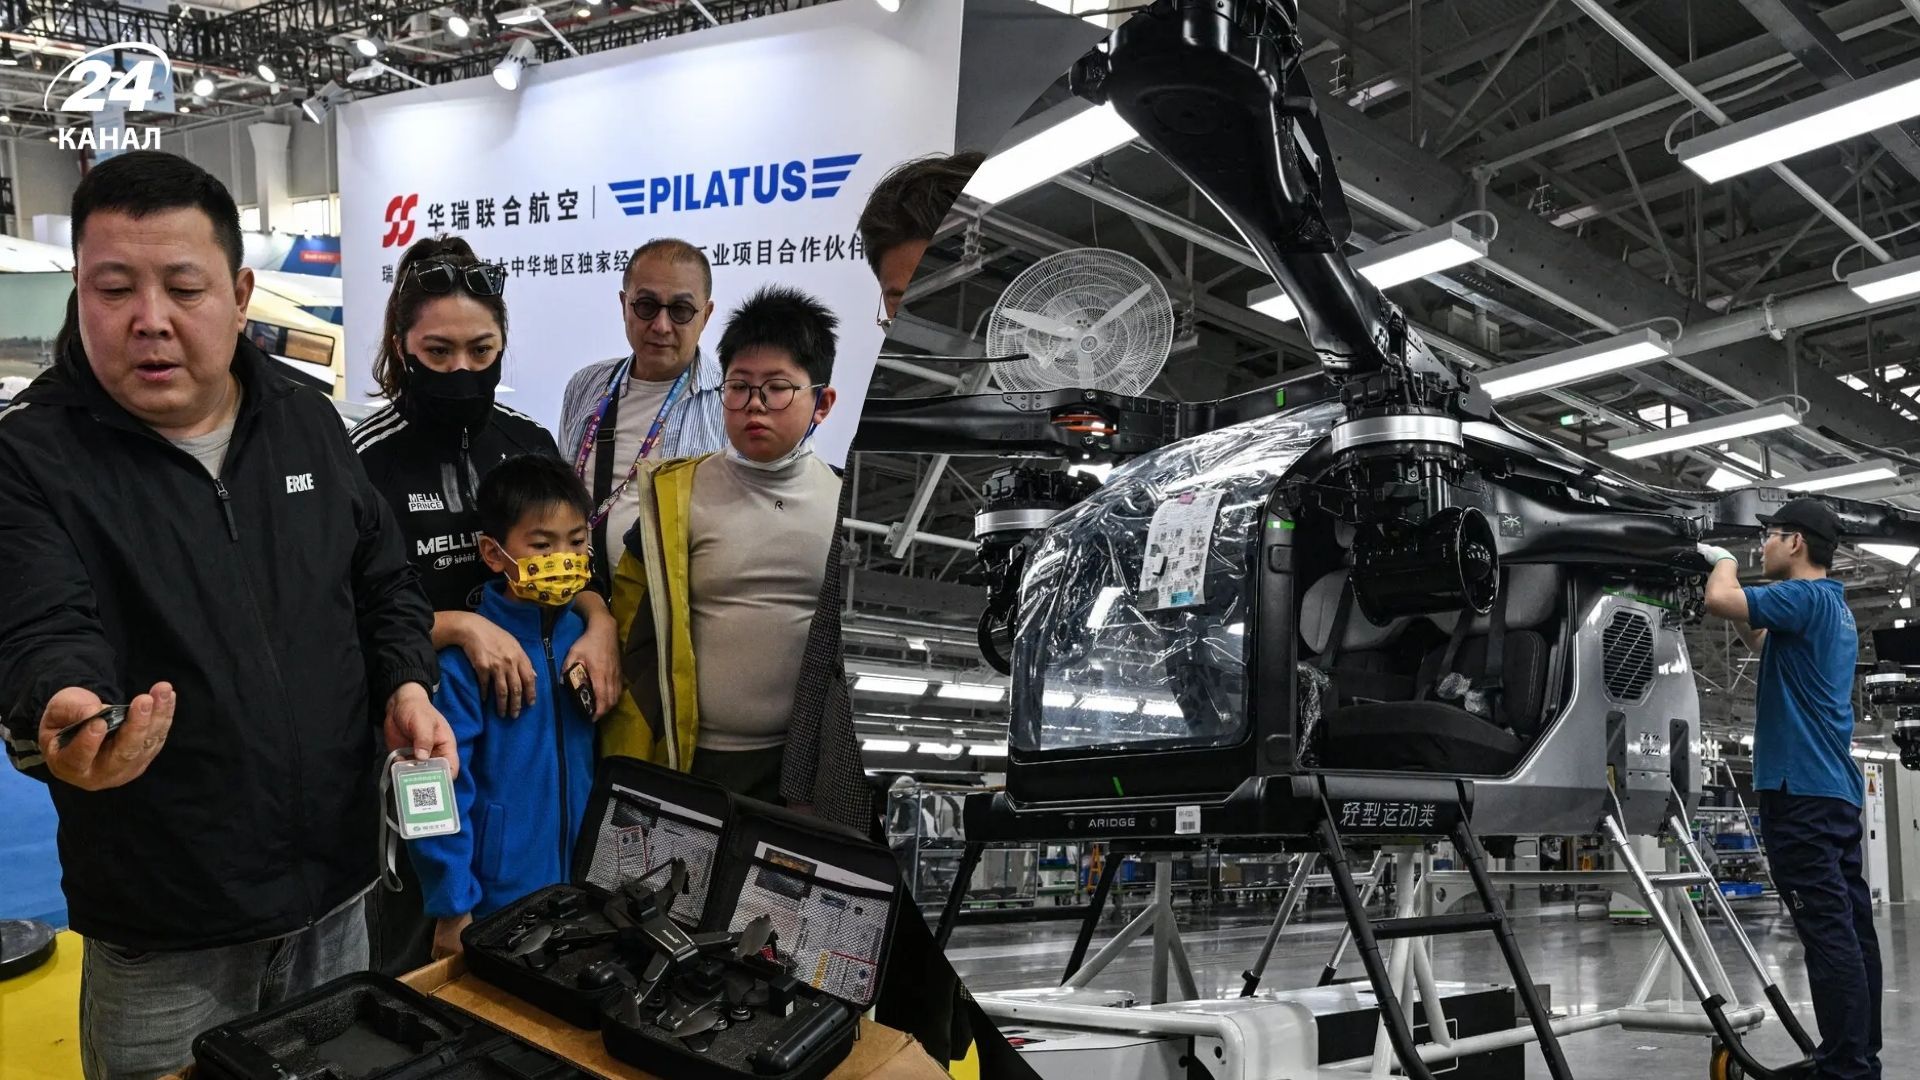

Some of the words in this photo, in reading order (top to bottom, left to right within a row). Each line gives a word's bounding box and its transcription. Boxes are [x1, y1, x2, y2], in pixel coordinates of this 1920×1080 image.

[650, 161, 807, 214] PILATUS
[427, 188, 579, 232] 华瑞联合航空
[286, 473, 315, 494] ERKE
[408, 493, 440, 502] MELLI
[410, 501, 442, 511] PRINCE
[1088, 818, 1136, 828] ARIDGE
[1340, 802, 1436, 827] 轻型运动类
